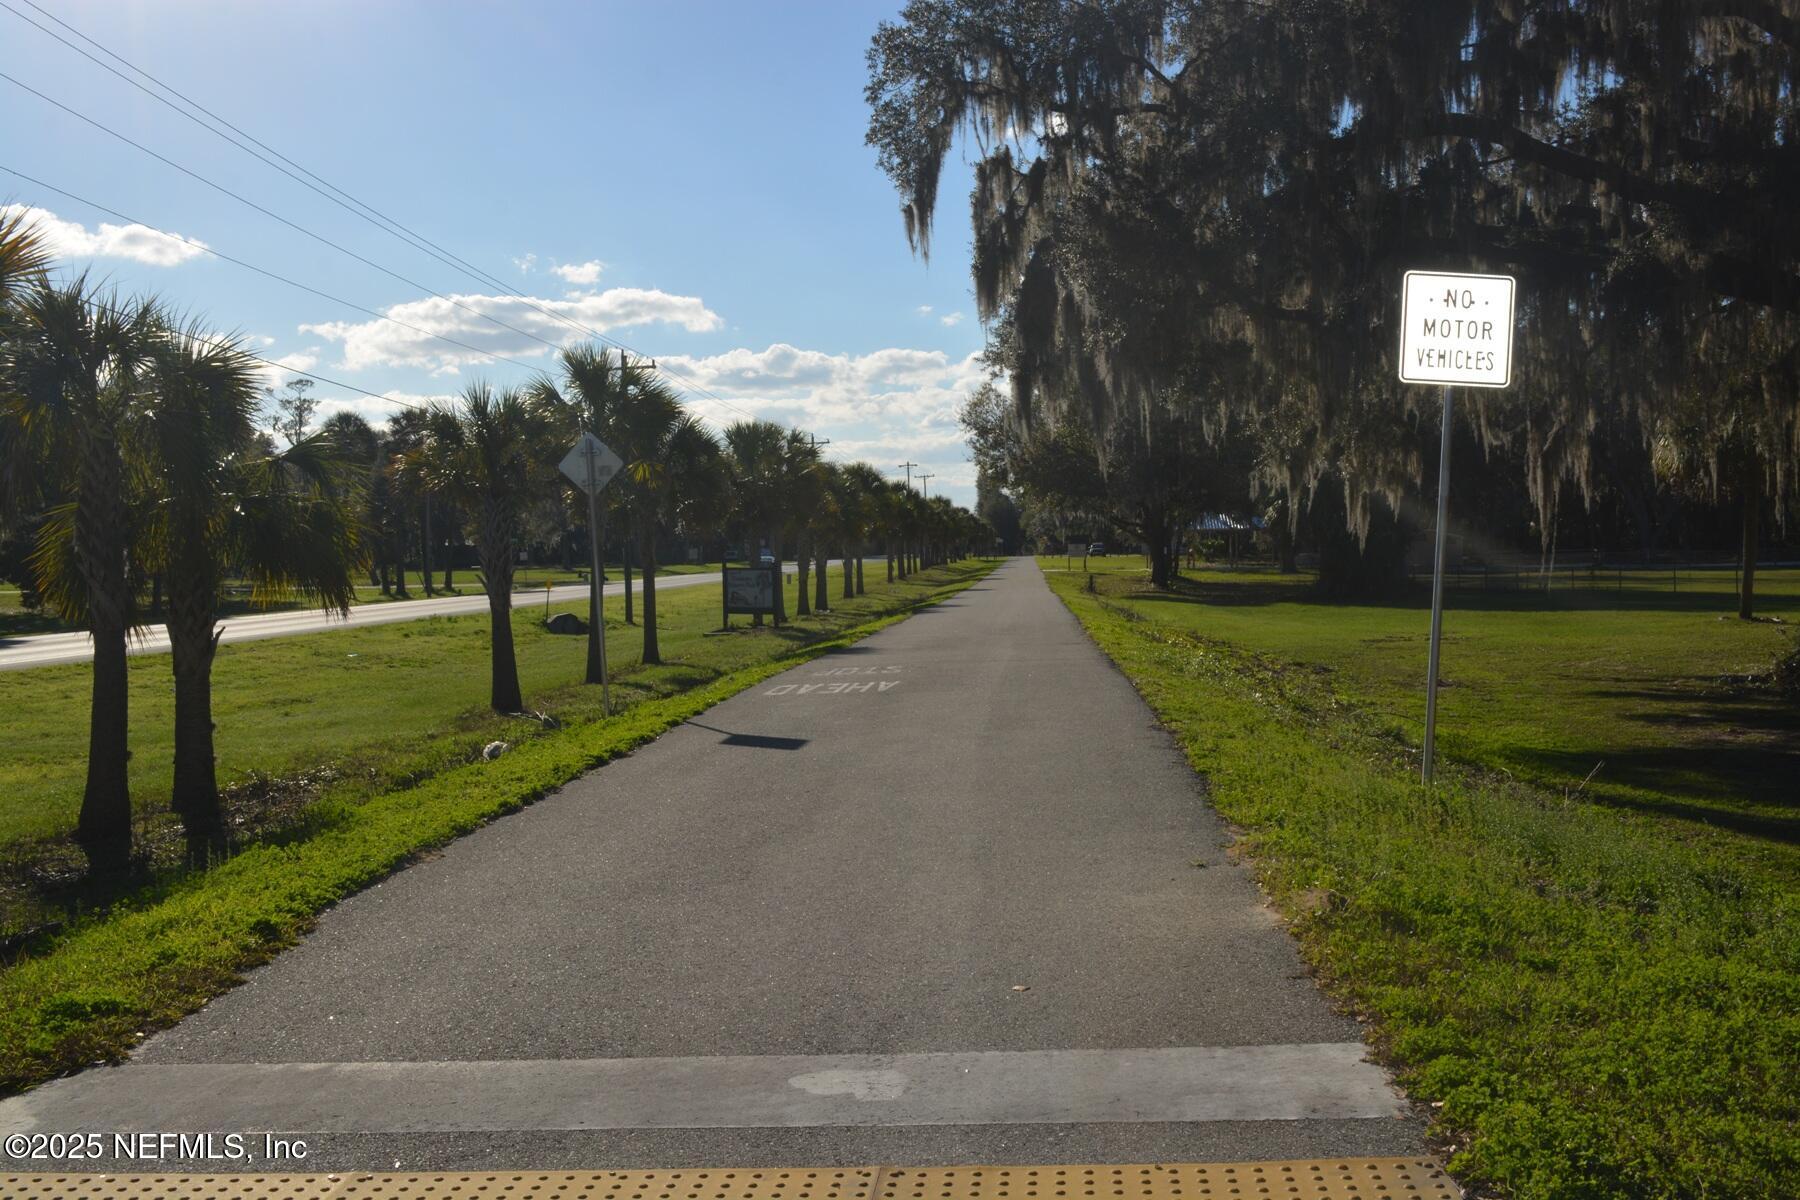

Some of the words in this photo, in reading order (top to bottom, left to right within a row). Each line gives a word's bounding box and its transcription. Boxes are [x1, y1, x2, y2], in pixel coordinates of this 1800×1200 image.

[1446, 289, 1472, 309] NO
[1423, 318, 1493, 340] MOTOR
[1417, 348, 1494, 371] VEHICLES
[813, 665, 902, 677] STOP
[763, 680, 901, 696] AHEAD
